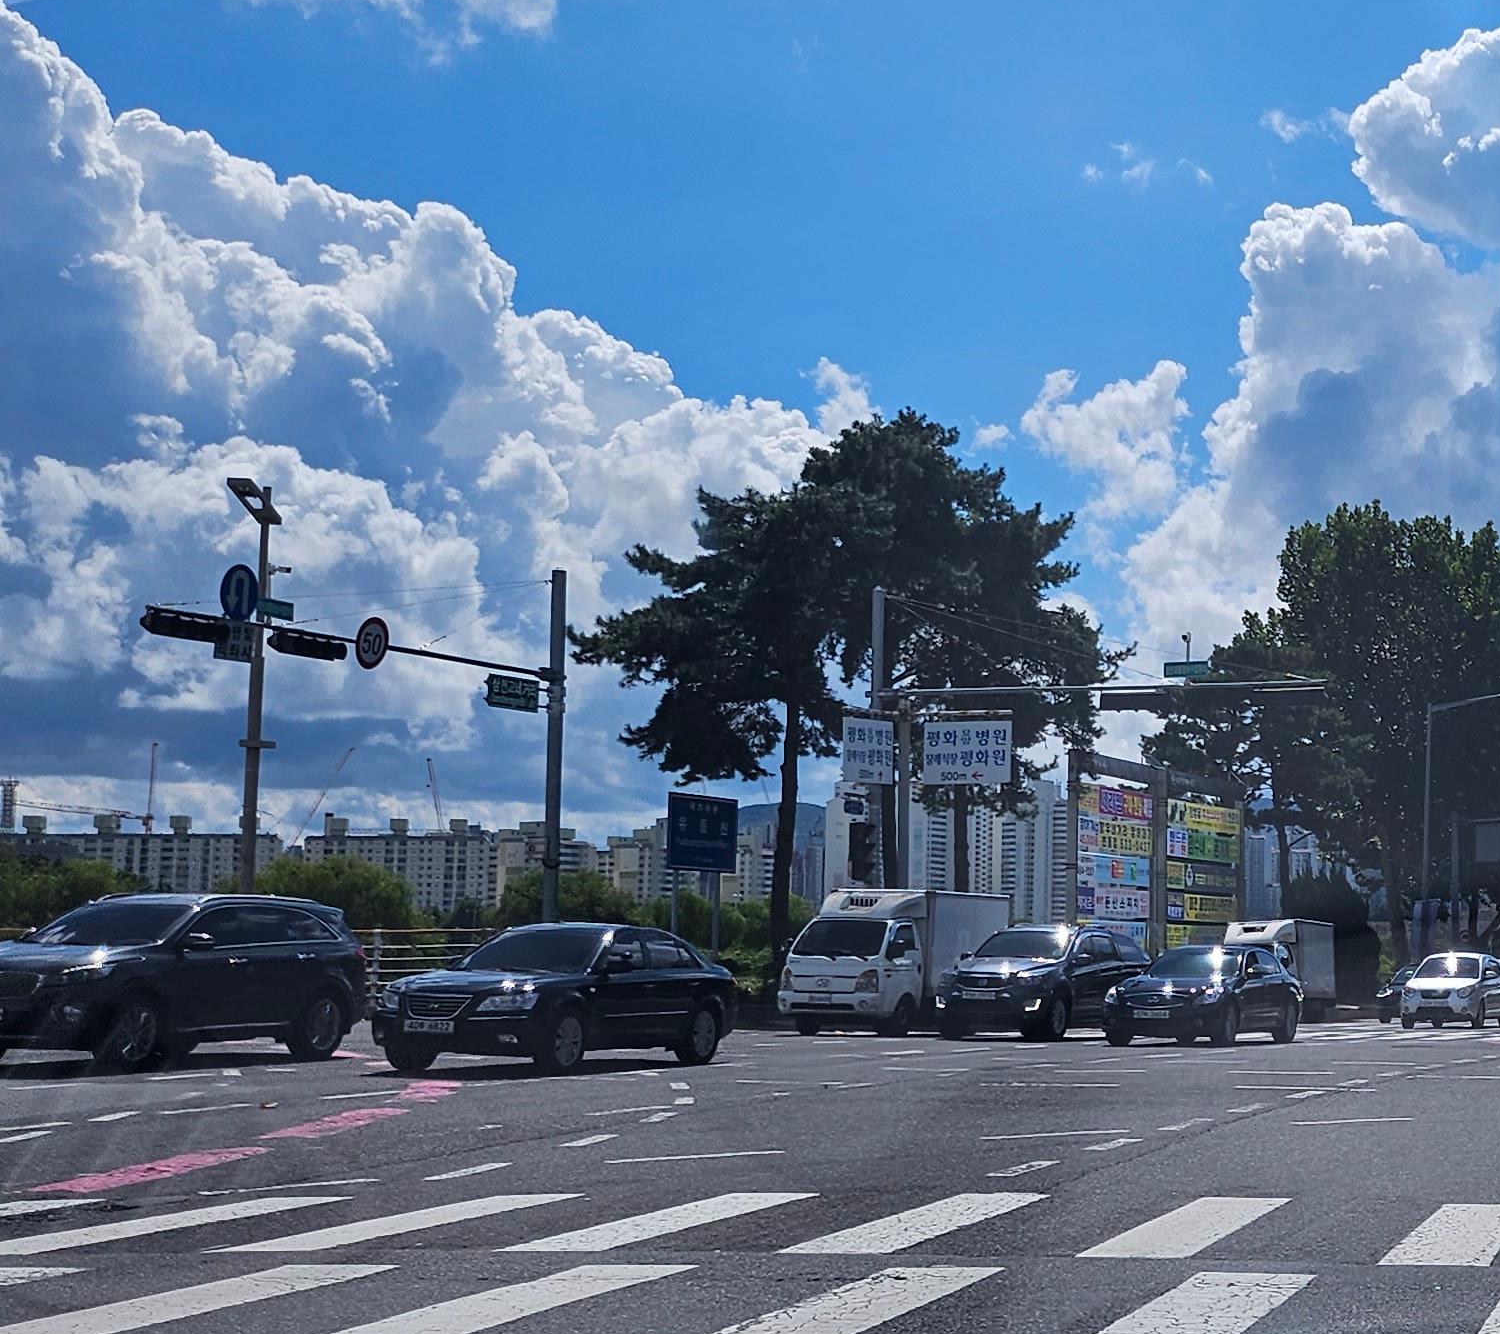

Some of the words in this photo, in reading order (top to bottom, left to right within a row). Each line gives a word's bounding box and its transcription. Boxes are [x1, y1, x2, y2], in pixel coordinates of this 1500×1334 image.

[362, 632, 382, 655] 50
[926, 730, 957, 747] 평화
[975, 729, 1008, 747] 병원
[959, 749, 1006, 767] 평화원
[940, 772, 968, 782] 500m
